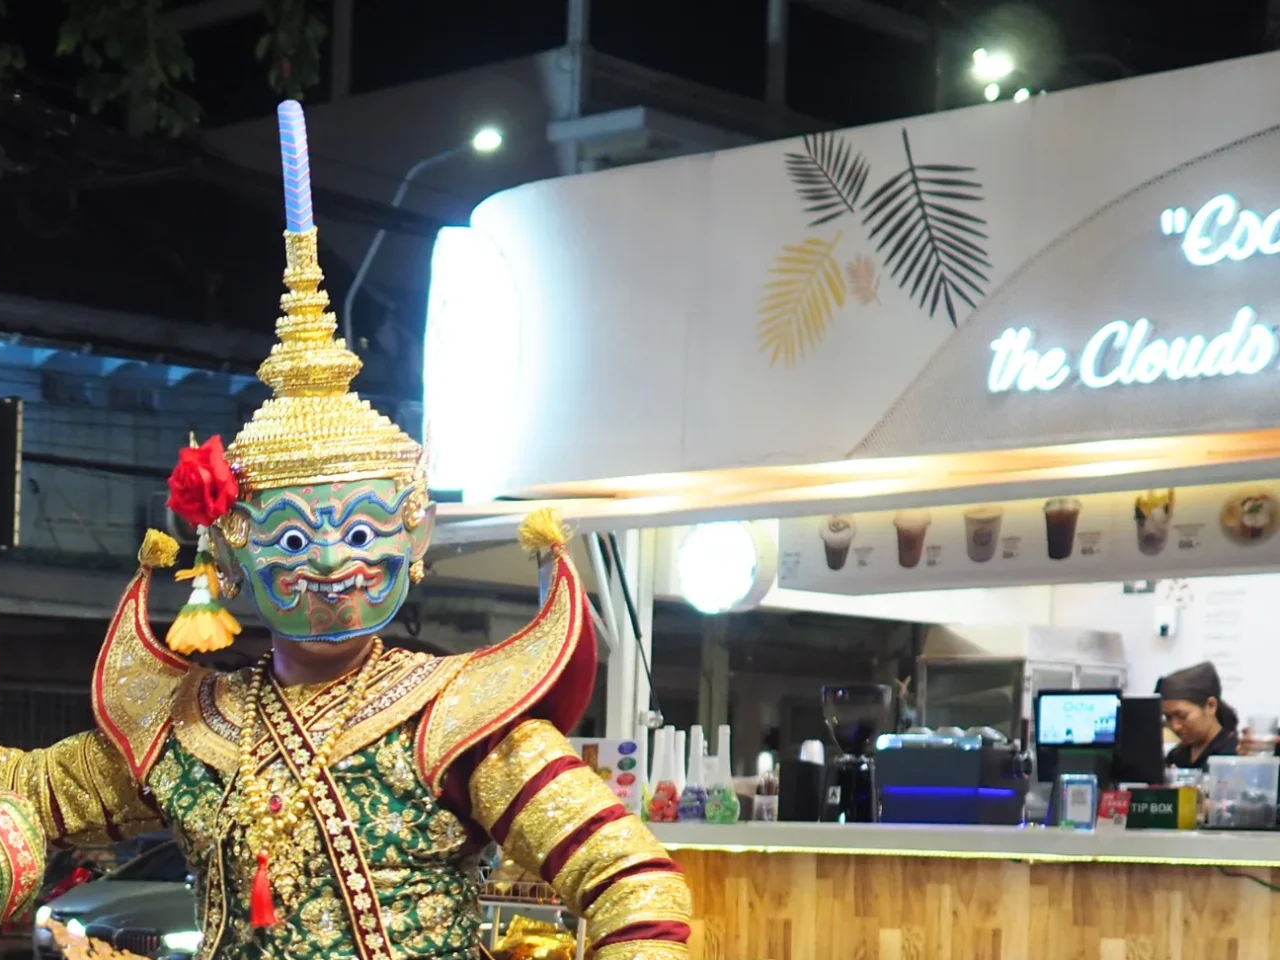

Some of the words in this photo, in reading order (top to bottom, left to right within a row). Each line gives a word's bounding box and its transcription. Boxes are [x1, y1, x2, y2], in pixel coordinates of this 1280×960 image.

[988, 326, 1071, 392] the
[1080, 305, 1277, 388] Clouds
[1131, 802, 1148, 814] TIP
[1149, 802, 1174, 814] BOX
